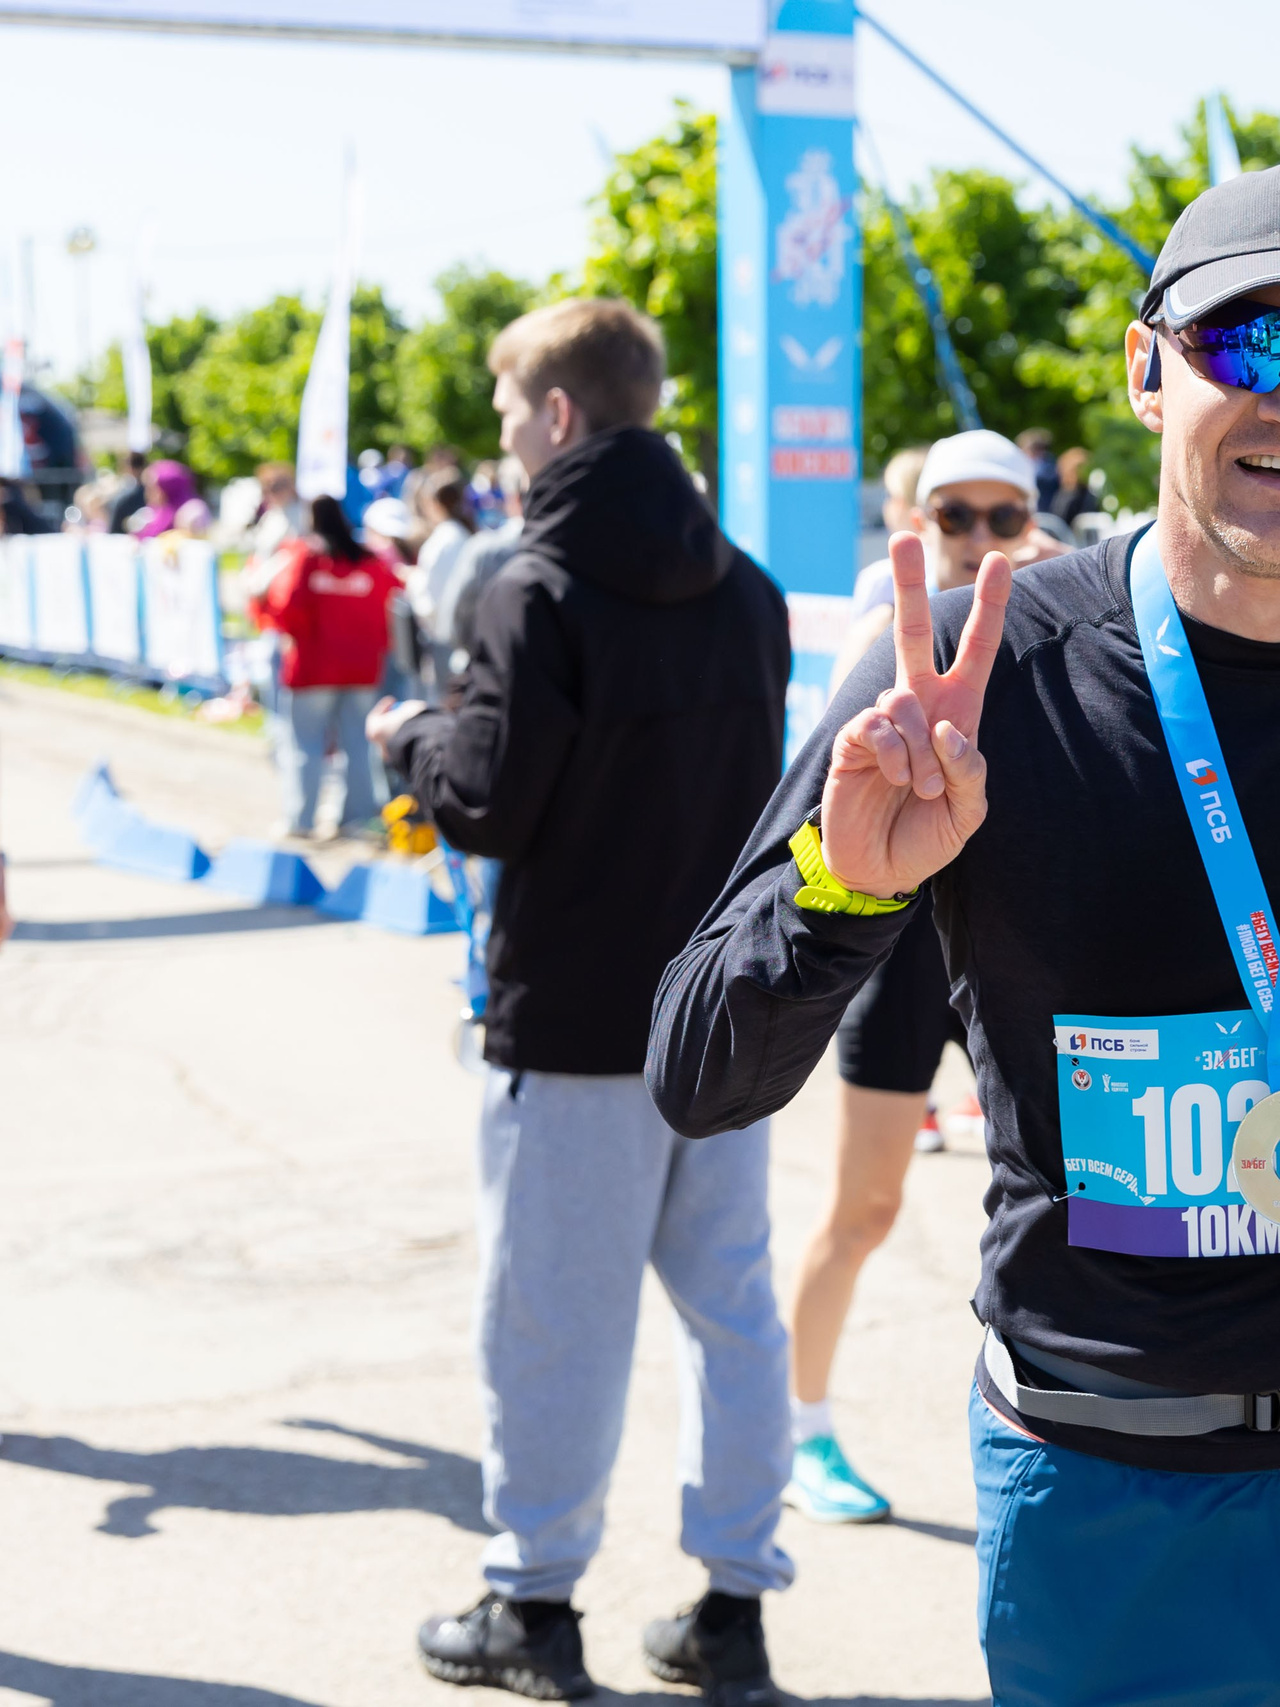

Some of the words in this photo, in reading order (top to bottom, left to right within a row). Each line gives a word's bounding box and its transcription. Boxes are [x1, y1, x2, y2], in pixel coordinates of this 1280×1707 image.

[1200, 790, 1232, 843] ПСБ
[1236, 924, 1260, 962] #ЛЮБИ
[1247, 960, 1266, 978] БЕГ
[1253, 979, 1269, 988] В
[1091, 1038, 1124, 1052] ПСБ
[1087, 1159, 1113, 1177] ВСЕМ
